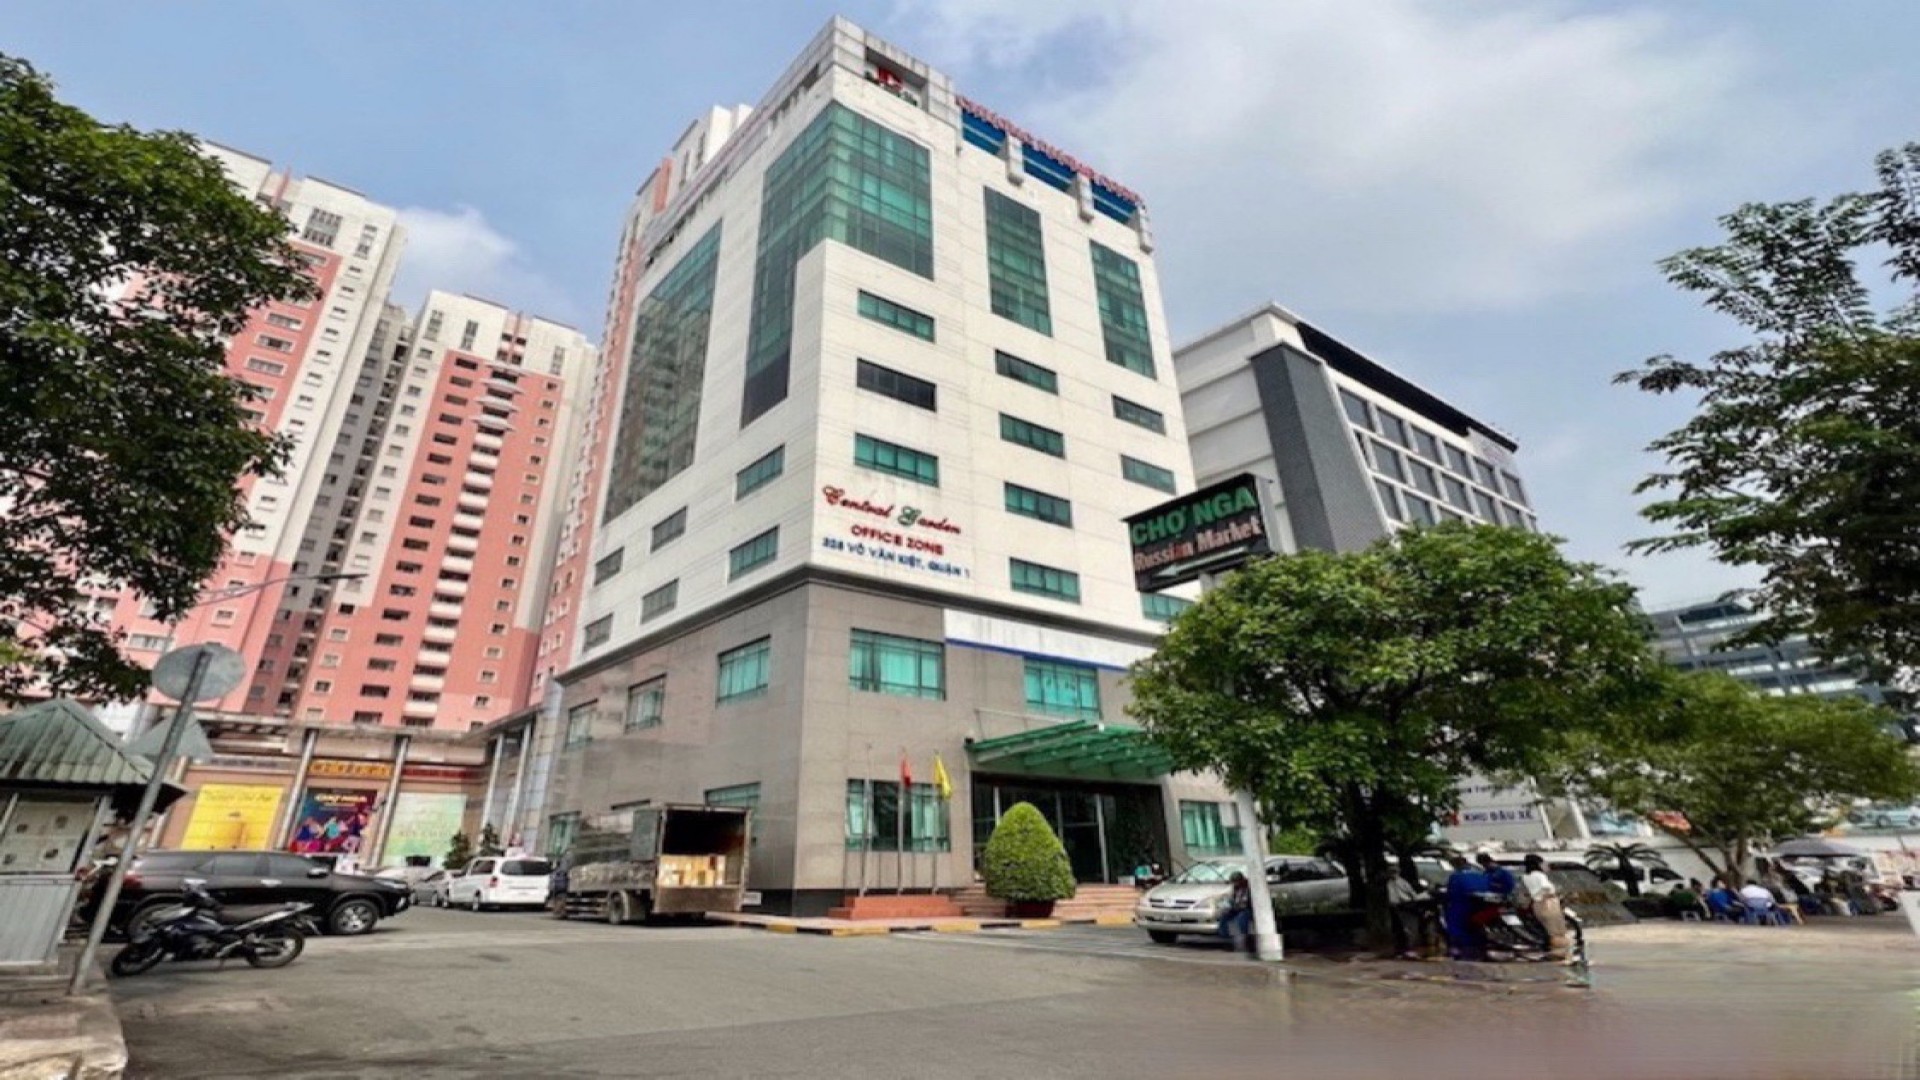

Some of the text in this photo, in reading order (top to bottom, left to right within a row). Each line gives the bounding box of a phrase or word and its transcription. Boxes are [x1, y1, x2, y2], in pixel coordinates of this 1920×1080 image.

[823, 485, 961, 534] Central Garden
[1132, 487, 1257, 546] CHỢ NGA
[851, 524, 944, 555] OFFICE ZONE
[1134, 515, 1261, 571] Russian Market
